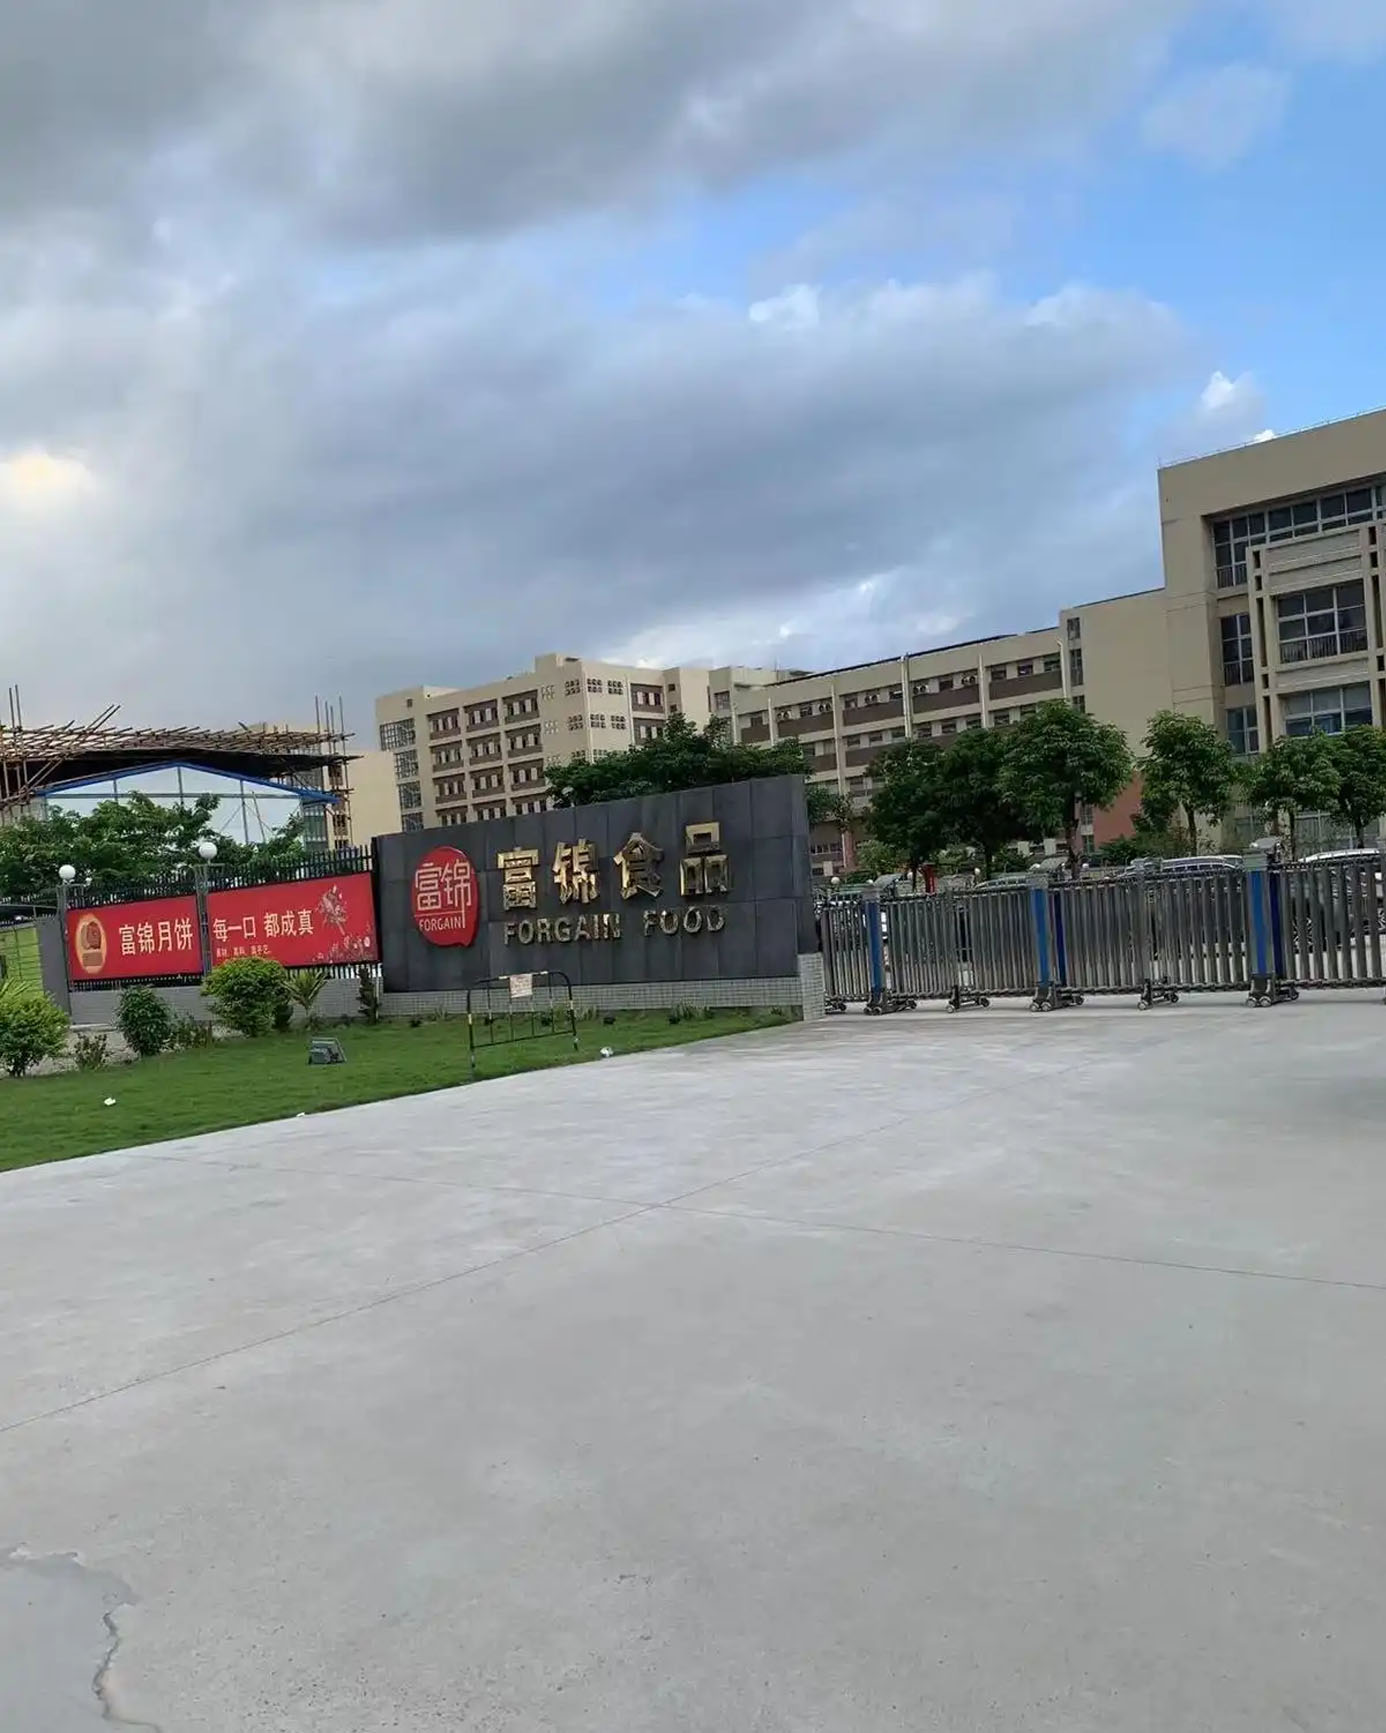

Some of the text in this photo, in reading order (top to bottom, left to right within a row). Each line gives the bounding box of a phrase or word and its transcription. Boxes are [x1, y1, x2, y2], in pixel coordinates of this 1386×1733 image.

[497, 822, 730, 909] 富锦食品
[414, 859, 472, 915] 富锦
[119, 919, 193, 956] 富锦月饼
[213, 909, 314, 942] 每一口 都成真
[419, 914, 462, 931] FORGAIN
[504, 904, 726, 945] FORGAIN FOOD
